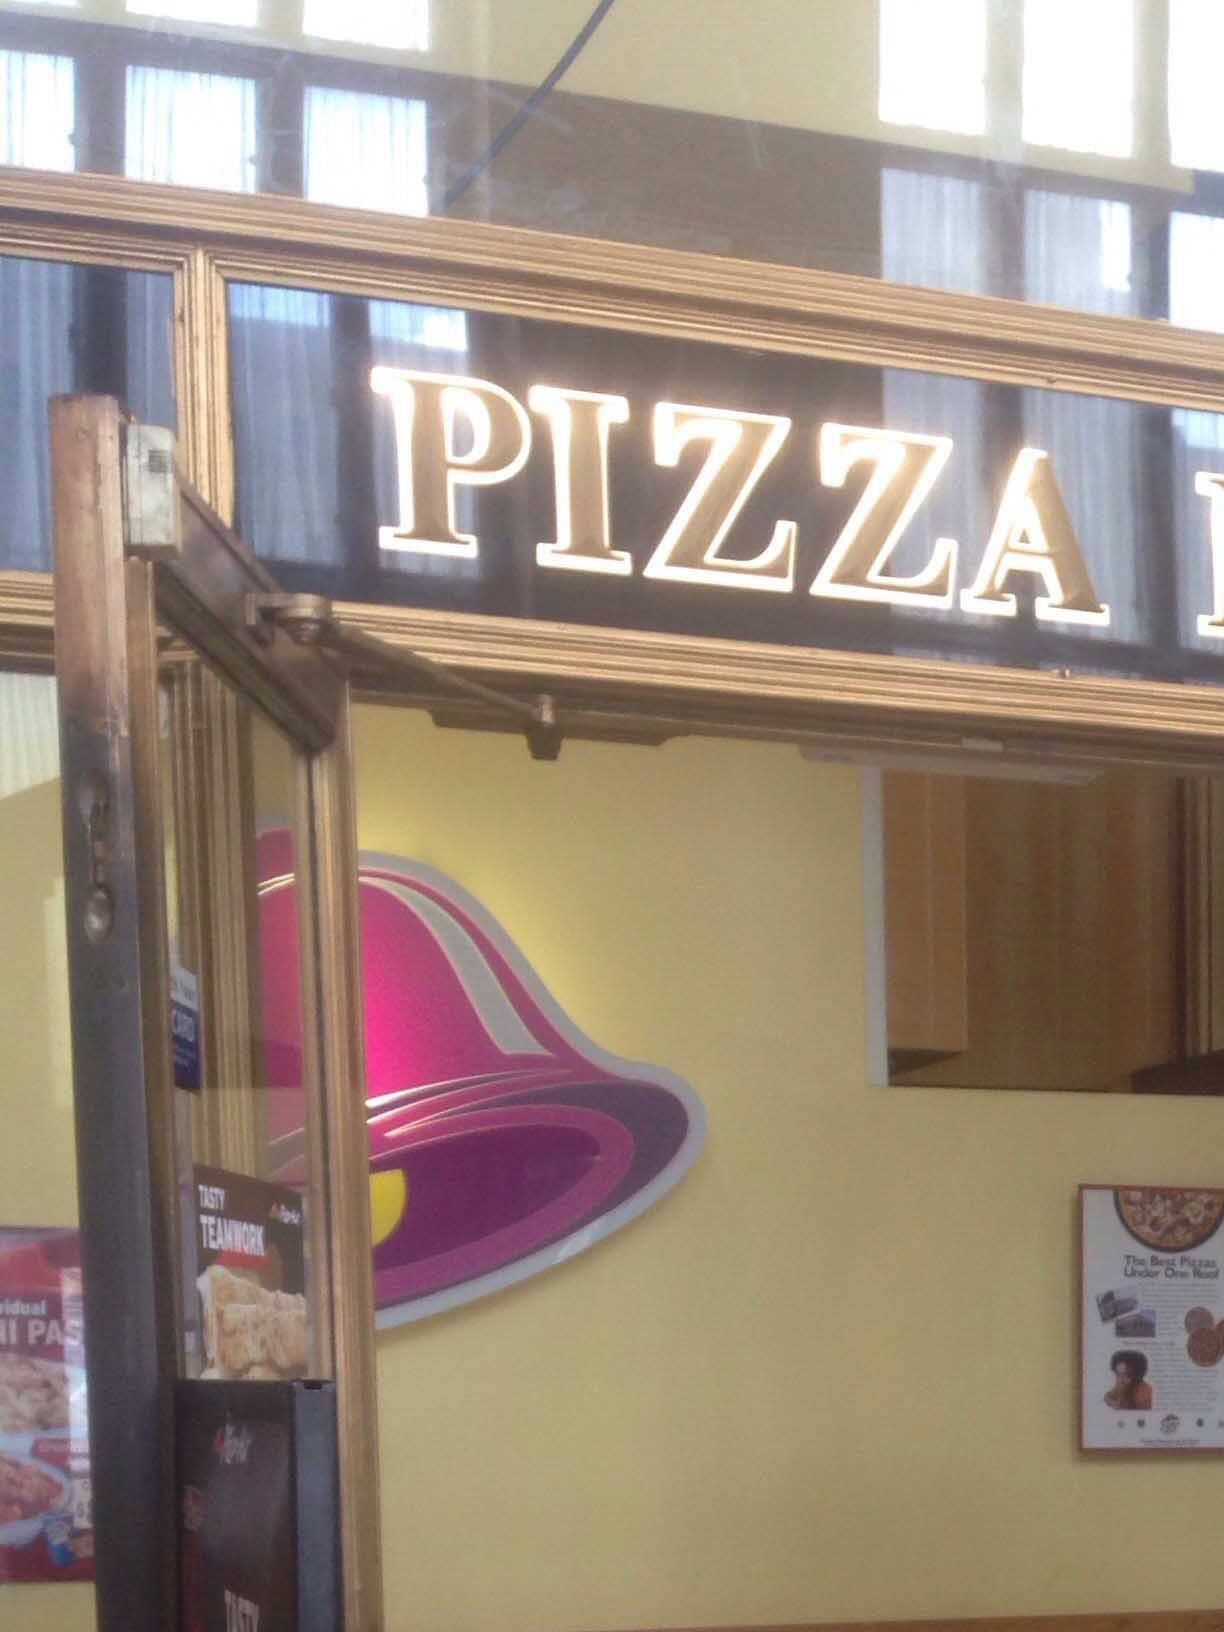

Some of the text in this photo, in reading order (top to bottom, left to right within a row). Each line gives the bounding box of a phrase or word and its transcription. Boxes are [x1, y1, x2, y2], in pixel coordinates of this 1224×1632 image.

[371, 365, 1110, 627] PIZZA
[199, 1184, 225, 1211] TASTY
[200, 1214, 265, 1256] TEAMWORK
[1124, 1254, 1146, 1266] The
[28, 1318, 83, 1346] PAS
